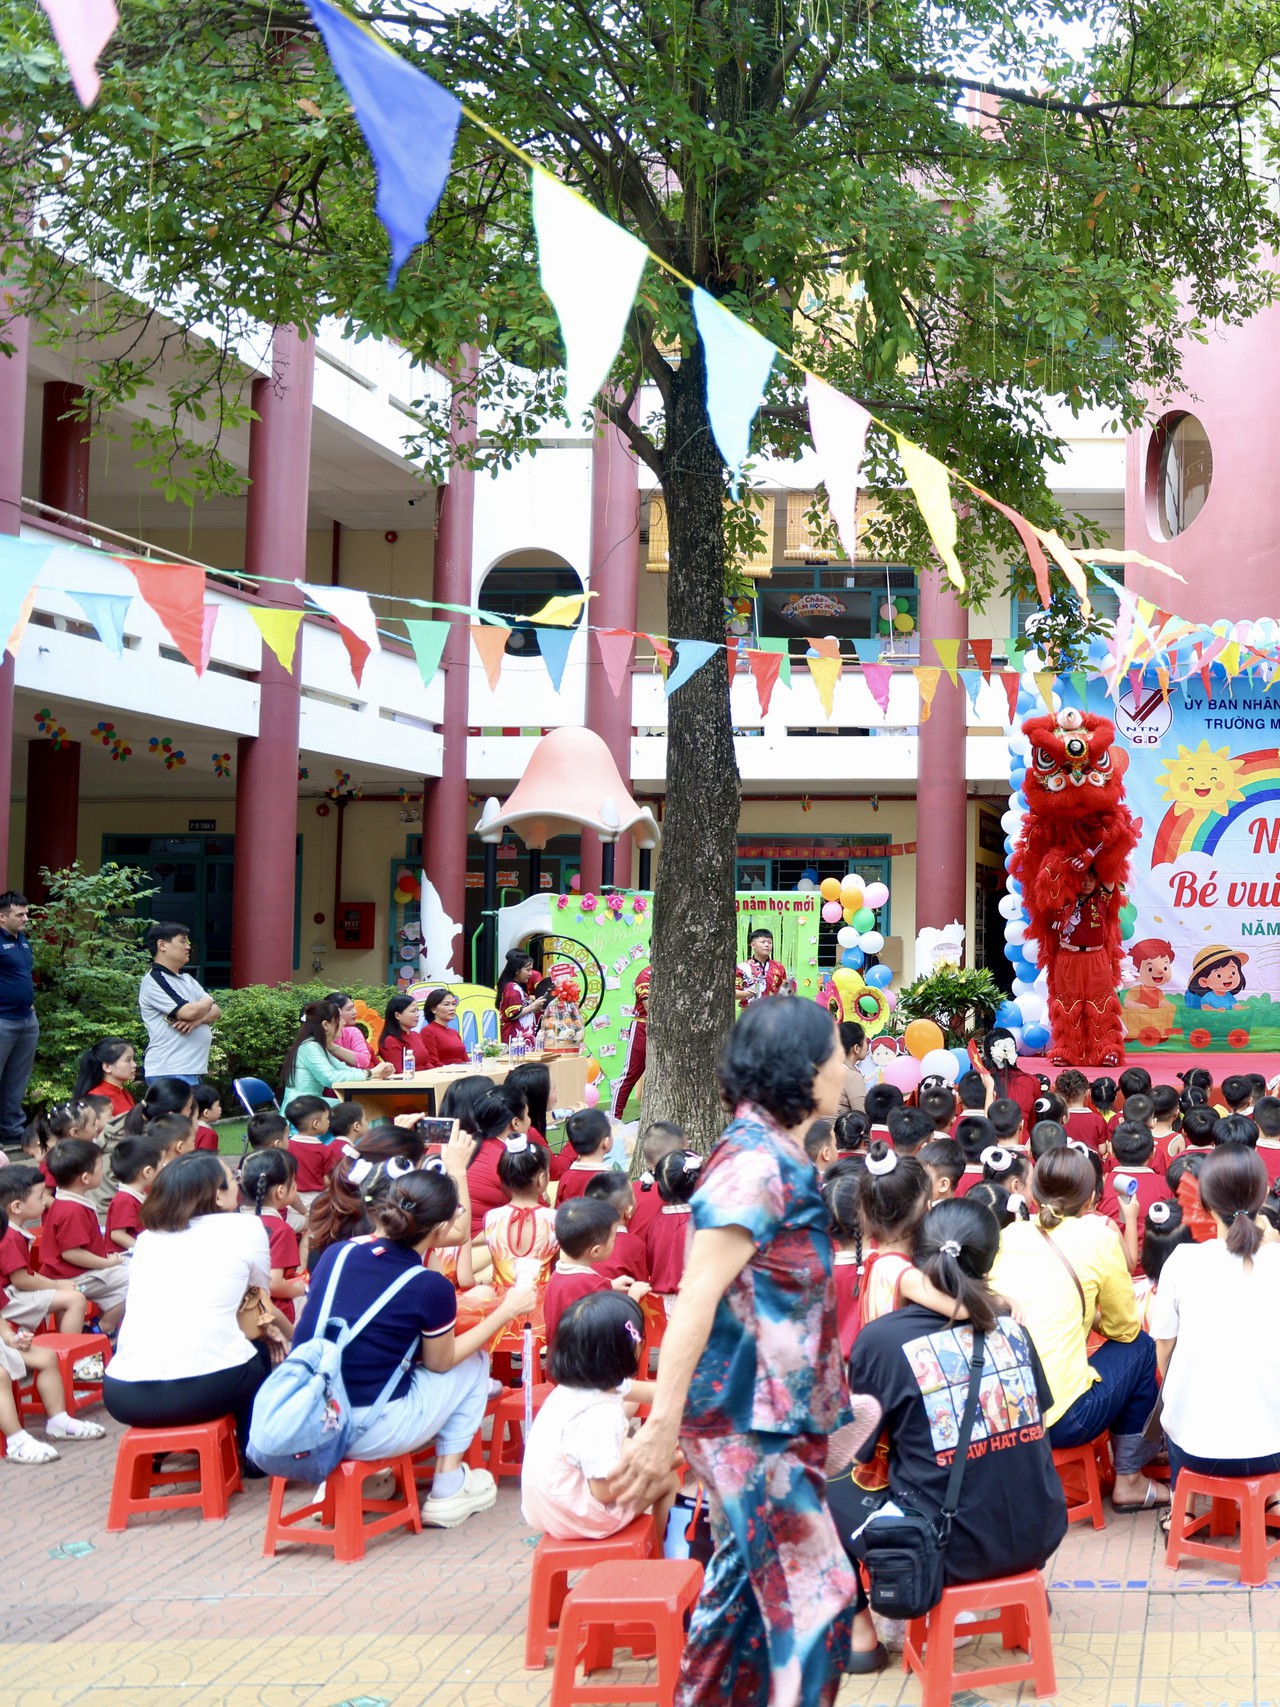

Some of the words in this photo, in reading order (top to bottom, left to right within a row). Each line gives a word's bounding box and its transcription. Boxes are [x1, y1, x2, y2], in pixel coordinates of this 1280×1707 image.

[1184, 694, 1203, 710] ỦY
[1208, 699, 1238, 710] BAN
[1205, 716, 1265, 730] TRƯỜNG
[1168, 870, 1219, 908] Bé
[742, 895, 767, 911] năm
[769, 897, 790, 915] học
[793, 895, 815, 911] mới
[1241, 919, 1280, 936] NĂM
[936, 1441, 988, 1467] STAW
[990, 1431, 1017, 1452] HAT
